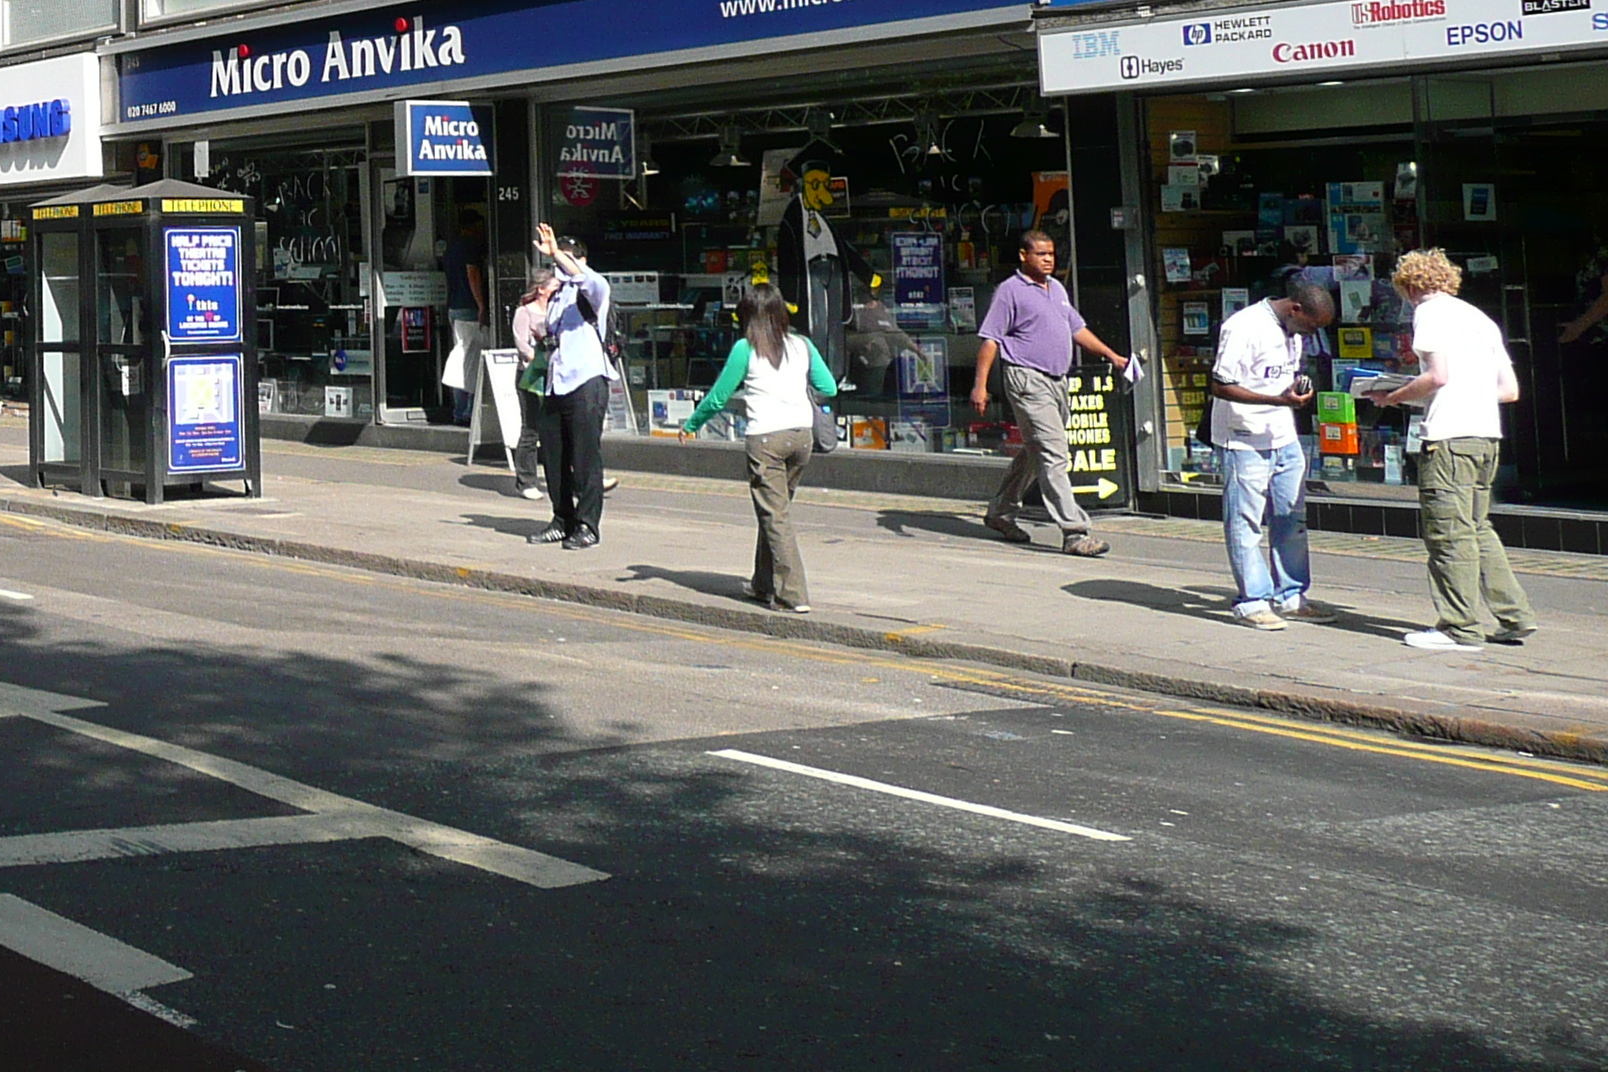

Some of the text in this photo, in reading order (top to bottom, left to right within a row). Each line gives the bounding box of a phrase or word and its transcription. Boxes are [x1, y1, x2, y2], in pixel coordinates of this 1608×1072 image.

[1214, 16, 1272, 31] HEWLETT
[1215, 28, 1272, 43] PACKARD
[1447, 20, 1523, 46] EPSON
[1072, 31, 1121, 59] IBM
[1272, 38, 1354, 64] Canon
[210, 15, 465, 98] Micro Anvika
[1142, 59, 1183, 75] Hayes
[127, 100, 176, 118] 020 7467 6000
[424, 115, 479, 137] Micro
[418, 138, 487, 160] Anvika
[498, 187, 519, 201] 245
[37, 206, 74, 218] TELEPHONE
[98, 201, 138, 214] TELEPHONE
[171, 199, 236, 212] TELEPHONE
[171, 235, 233, 248] HALF PRICE
[178, 247, 226, 259] THEATRE
[180, 259, 225, 271] TICKETS
[172, 270, 233, 287] TONIGHT!
